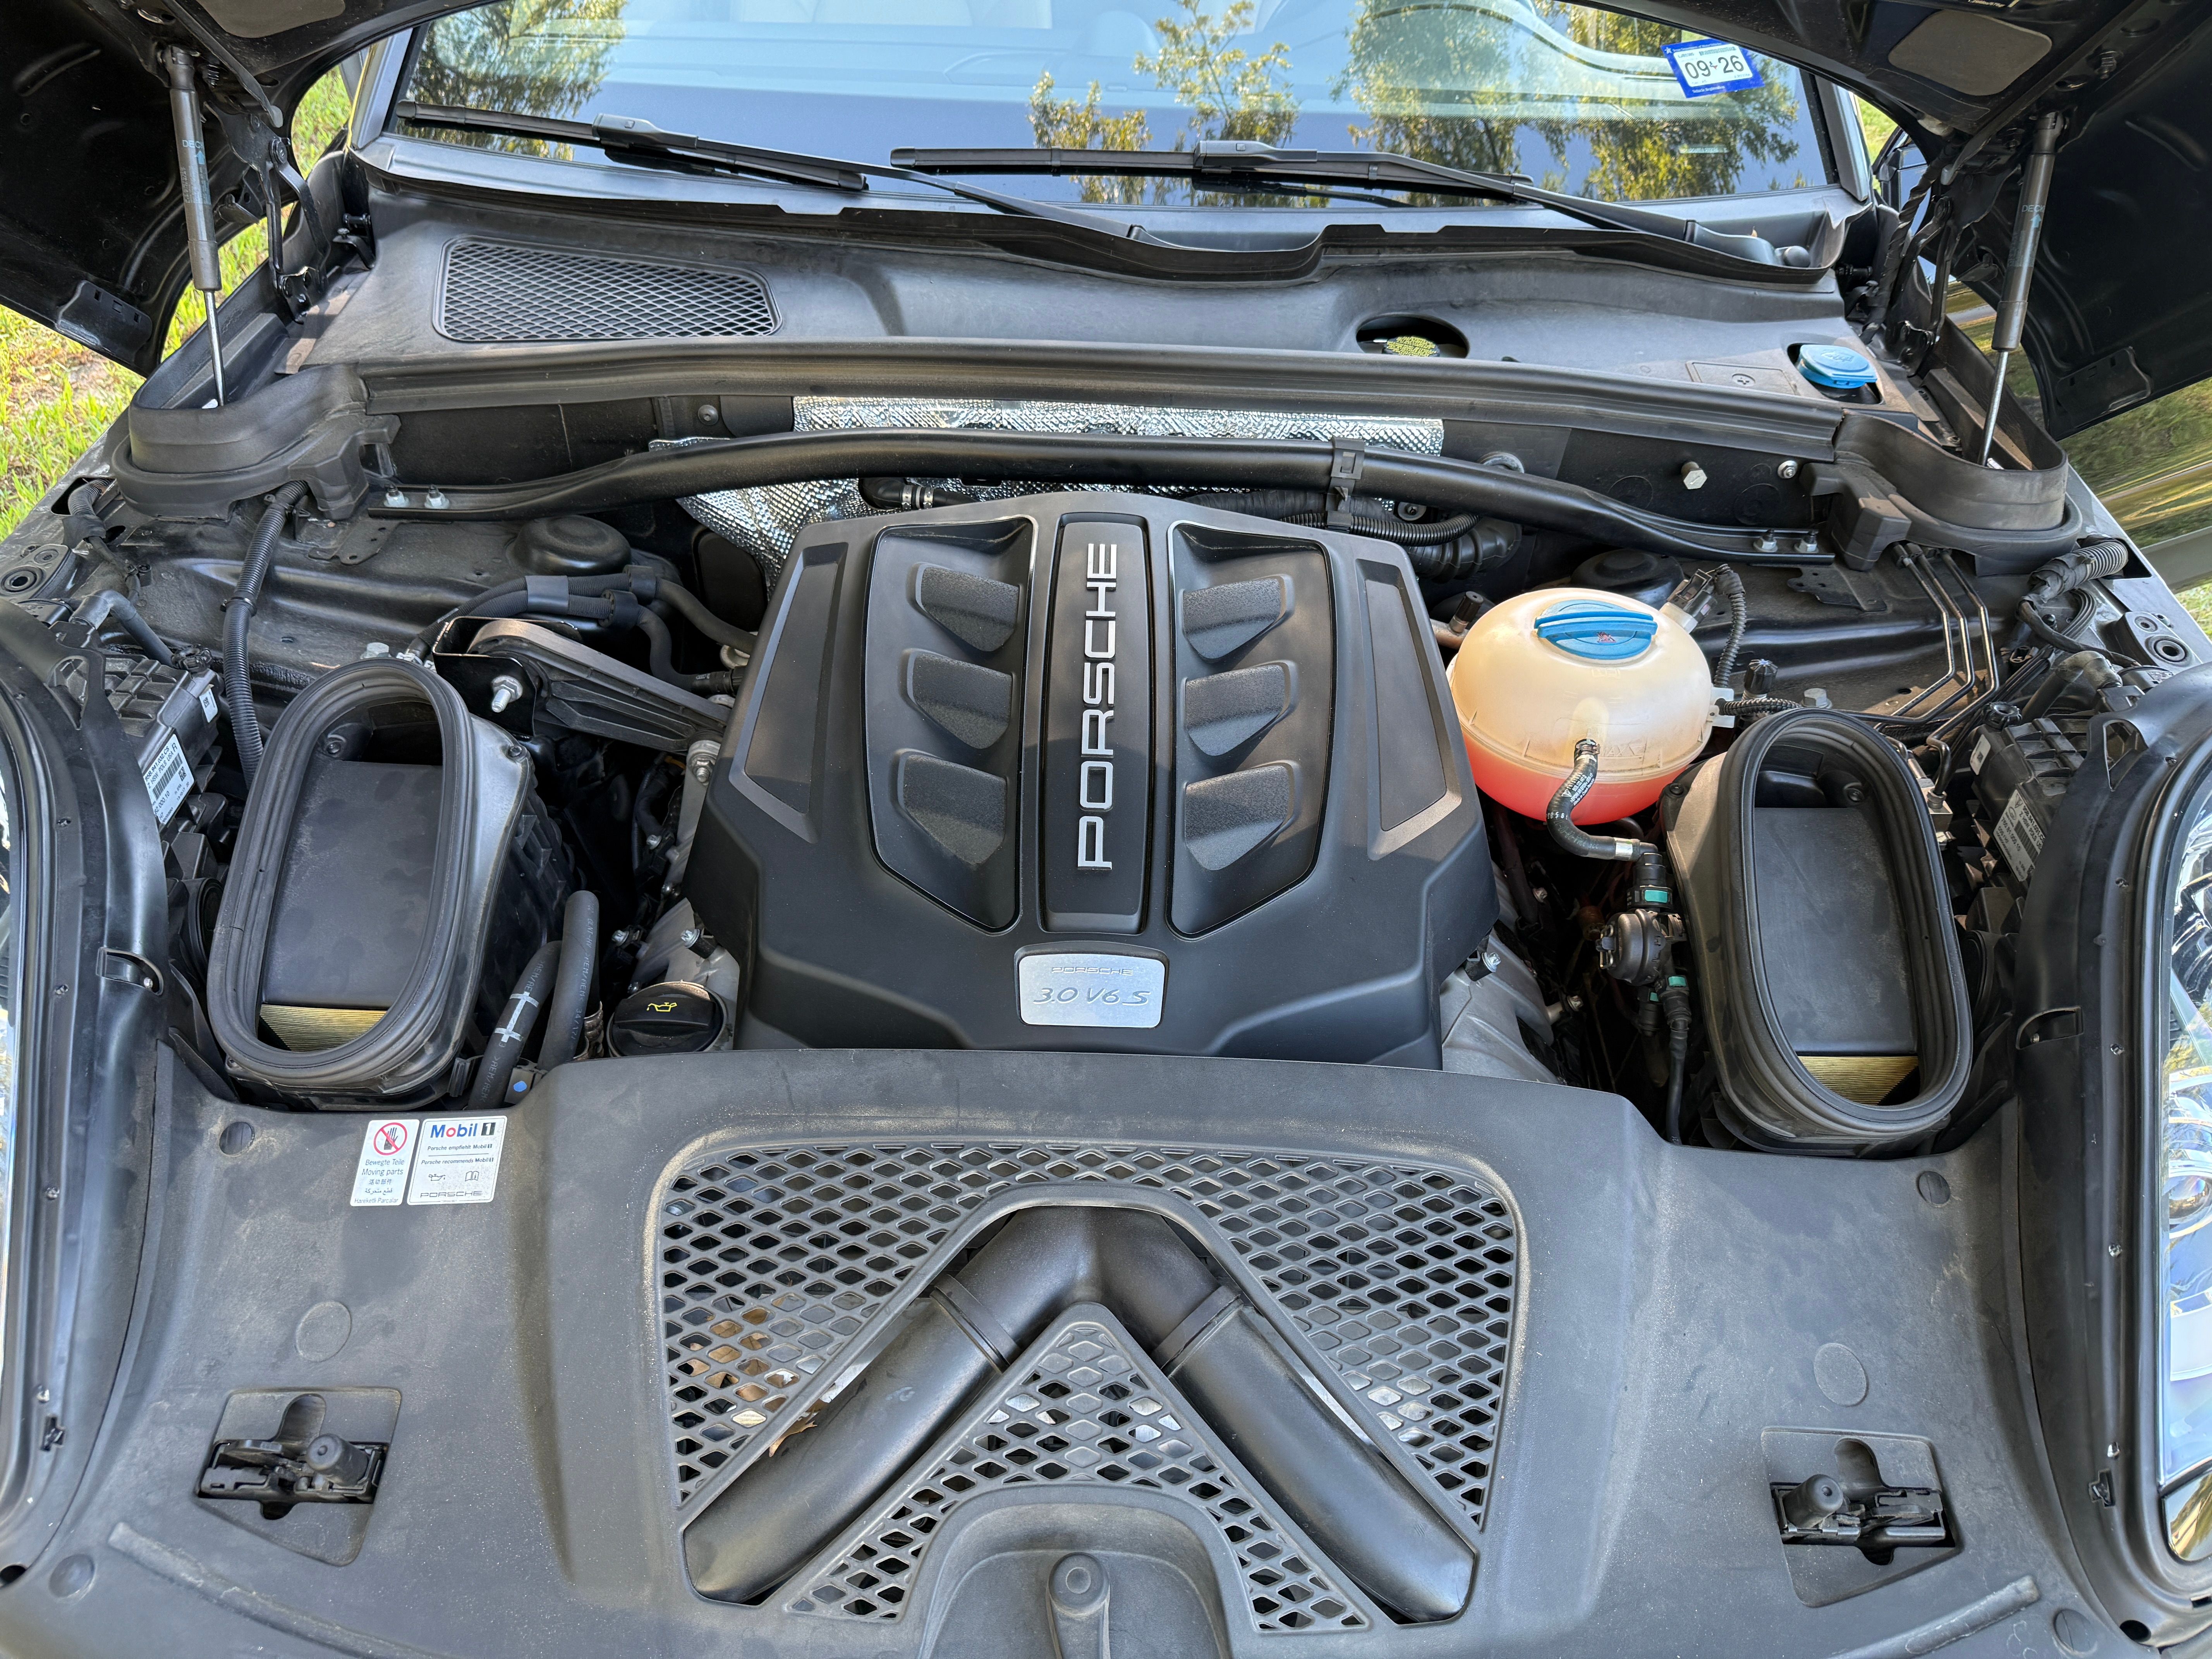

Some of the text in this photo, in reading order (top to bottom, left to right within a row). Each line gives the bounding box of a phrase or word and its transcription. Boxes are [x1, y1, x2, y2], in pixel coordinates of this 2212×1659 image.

[1685, 55, 1744, 79] 09 26
[1077, 543, 1117, 870] PORSCHE
[172, 743, 177, 752] R
[1051, 967, 1133, 976] PORSCHE
[1033, 987, 1152, 1006] 3.0 V6 S
[430, 1123, 478, 1138] Mobil
[362, 1168, 385, 1176] Moving
